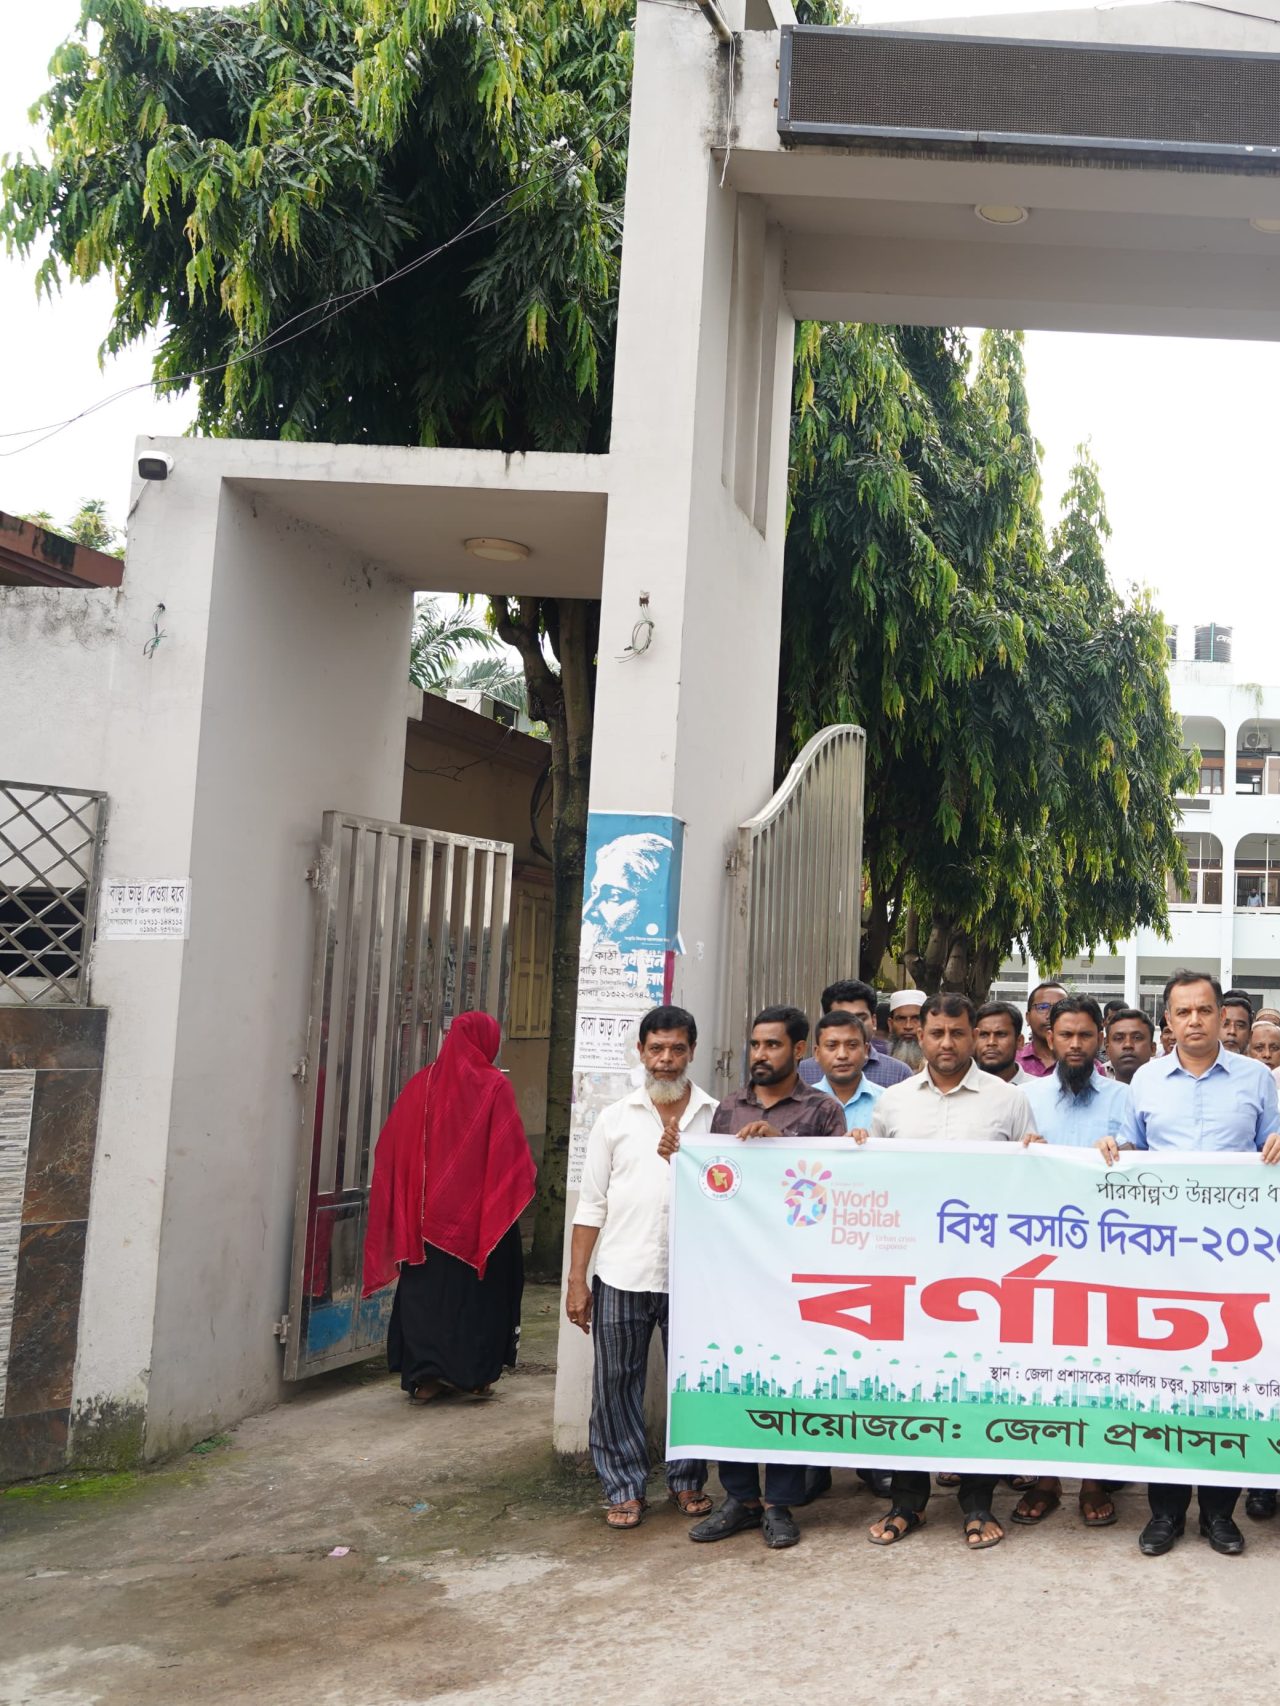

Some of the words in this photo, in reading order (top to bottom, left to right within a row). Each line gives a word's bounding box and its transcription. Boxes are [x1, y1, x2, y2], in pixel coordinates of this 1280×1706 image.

[831, 1189, 889, 1208] World
[1096, 1171, 1180, 1206] পরিকল্পিত
[1186, 1179, 1260, 1210] উন্নয়নের
[832, 1207, 902, 1228] Habitat
[937, 1197, 999, 1249] বিশ্ব
[1007, 1204, 1089, 1250] বসতি
[831, 1226, 871, 1250] Day
[792, 1254, 1270, 1363] বর্ণাঢ্য
[988, 1366, 1011, 1383] স্থান
[1025, 1368, 1053, 1383] জেলা
[1057, 1369, 1112, 1385] প্রশাসকের
[1115, 1370, 1157, 1389] কার্যালয়
[1192, 1379, 1237, 1396] চুয়াডাঙ্গা
[985, 1418, 1089, 1448] জেলা
[1104, 1422, 1249, 1458] প্রশাসন
